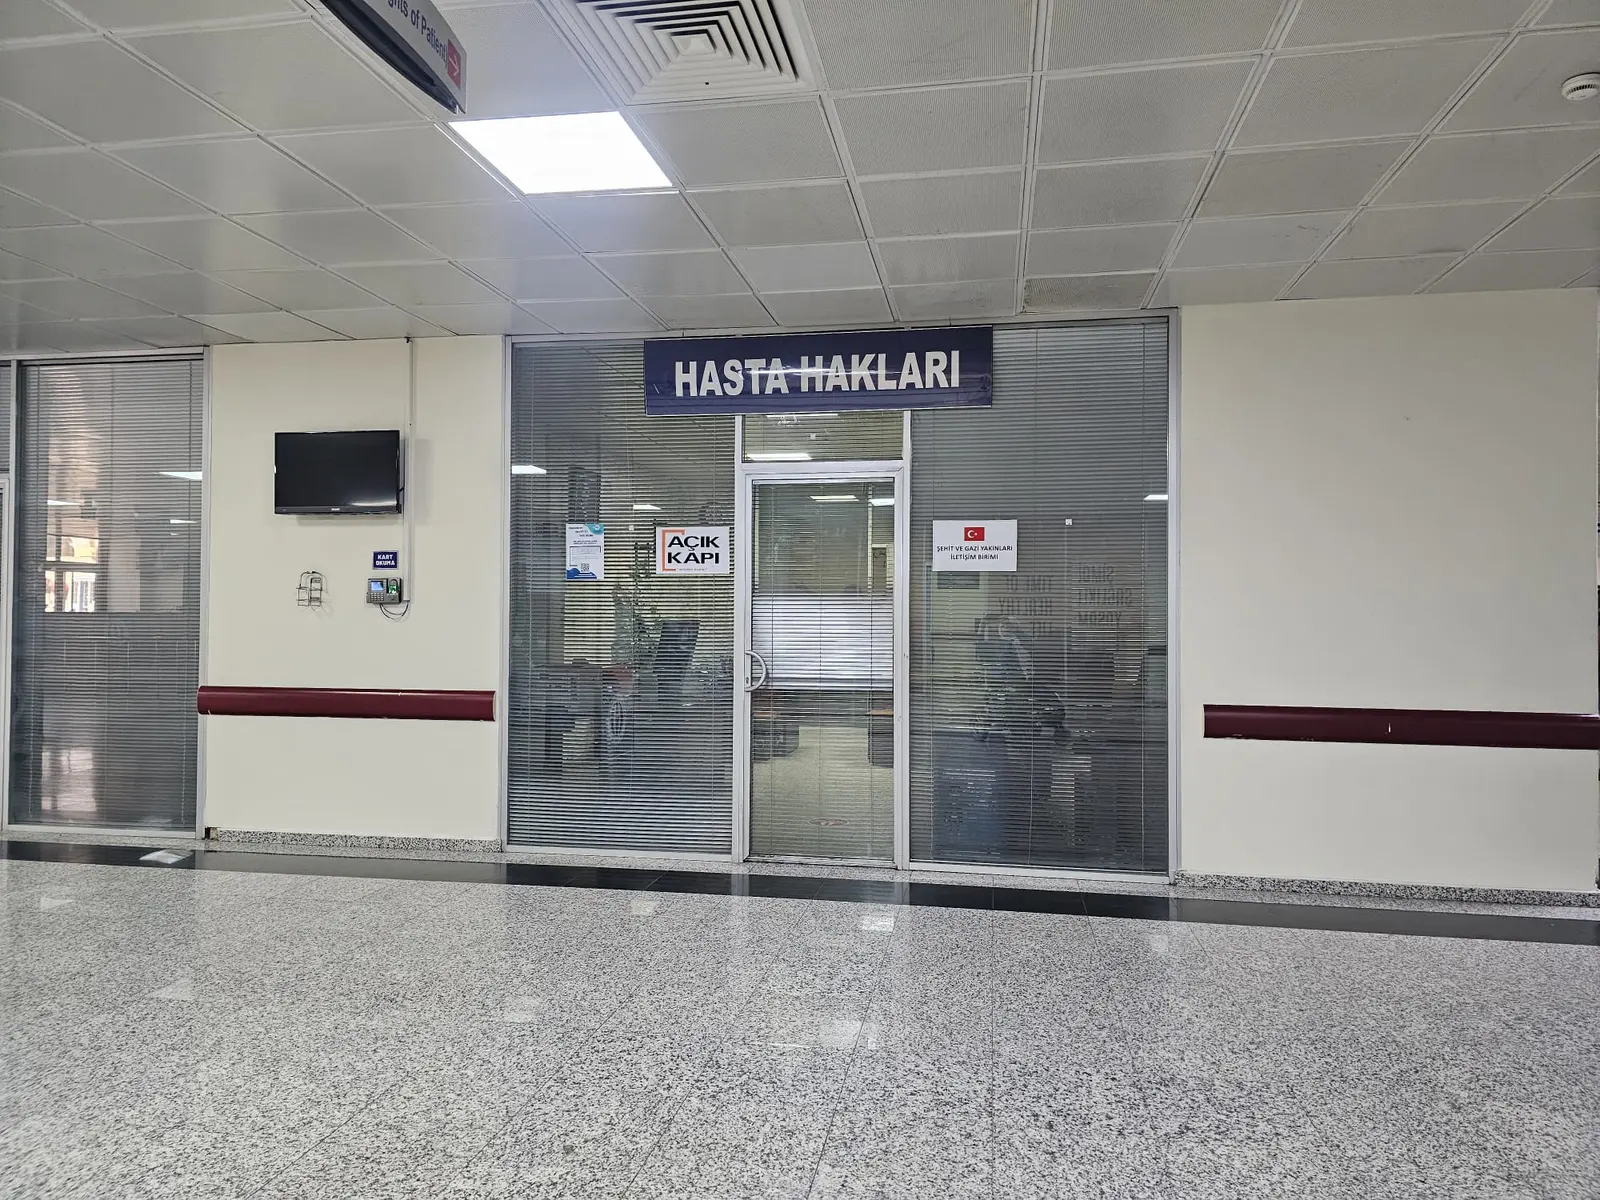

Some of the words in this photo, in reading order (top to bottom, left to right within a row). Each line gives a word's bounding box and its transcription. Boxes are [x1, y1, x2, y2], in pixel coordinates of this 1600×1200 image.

[411, 9, 419, 29] of
[675, 358, 789, 397] HASTA
[800, 350, 960, 392] HAKLARI
[667, 535, 720, 551] AÇIK
[667, 552, 720, 564] KAPI
